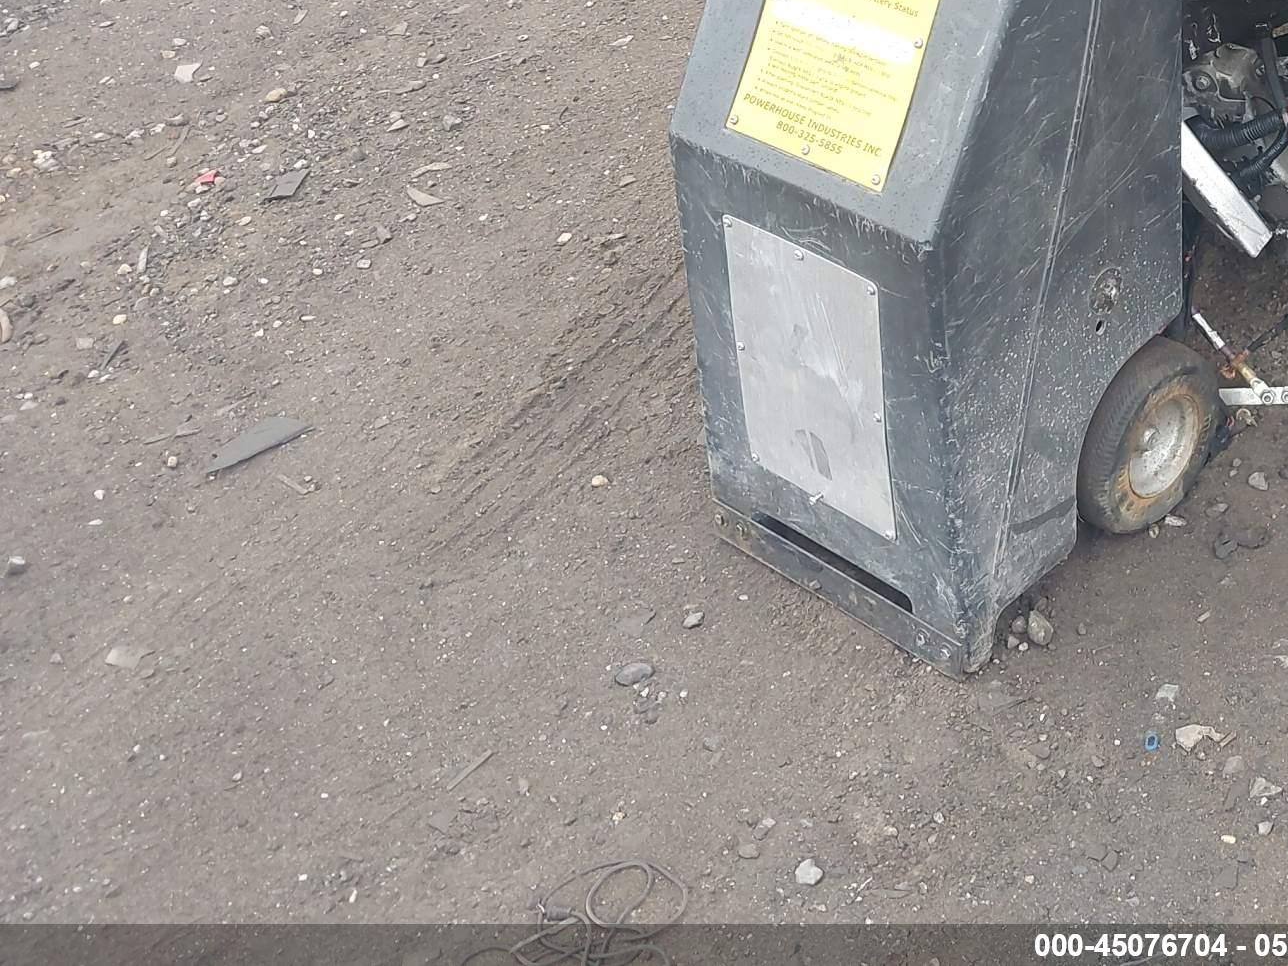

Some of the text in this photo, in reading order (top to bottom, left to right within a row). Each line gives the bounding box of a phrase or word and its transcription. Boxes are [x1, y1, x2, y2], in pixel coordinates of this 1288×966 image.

[894, 1, 919, 18] Status
[743, 93, 882, 157] POWERHOUSE INDUSTRIES INC
[776, 120, 843, 155] 800-325-5855
